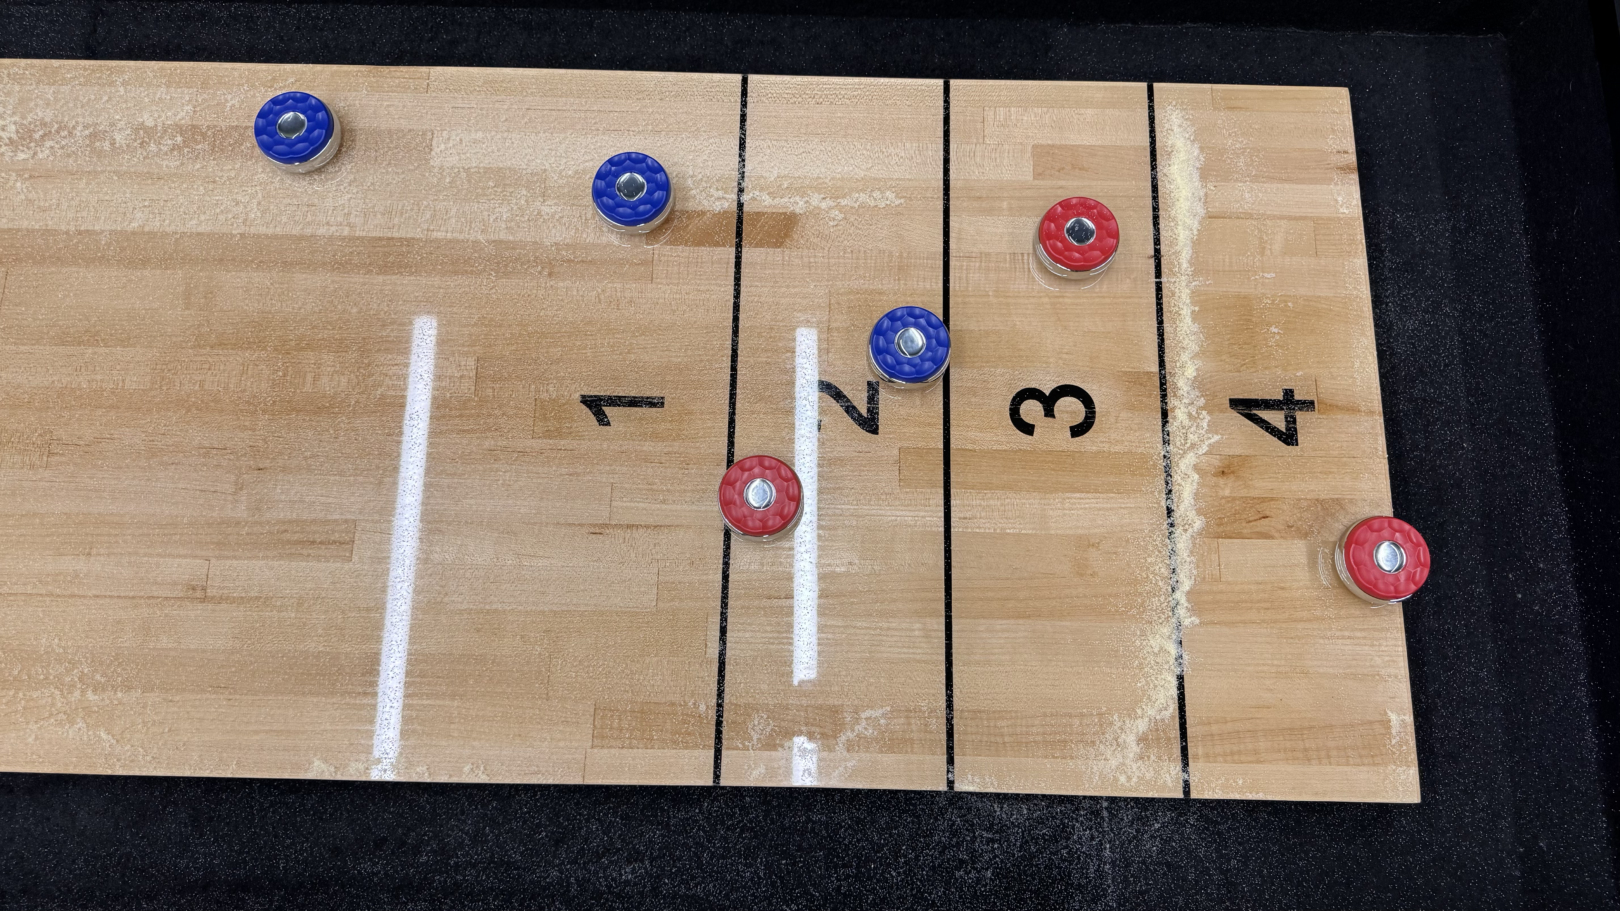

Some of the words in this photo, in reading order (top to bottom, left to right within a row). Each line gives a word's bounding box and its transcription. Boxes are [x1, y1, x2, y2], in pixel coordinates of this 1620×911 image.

[580, 394, 665, 427] 1
[817, 380, 880, 436] 2
[1008, 383, 1096, 439] 3
[1229, 387, 1316, 447] 4
